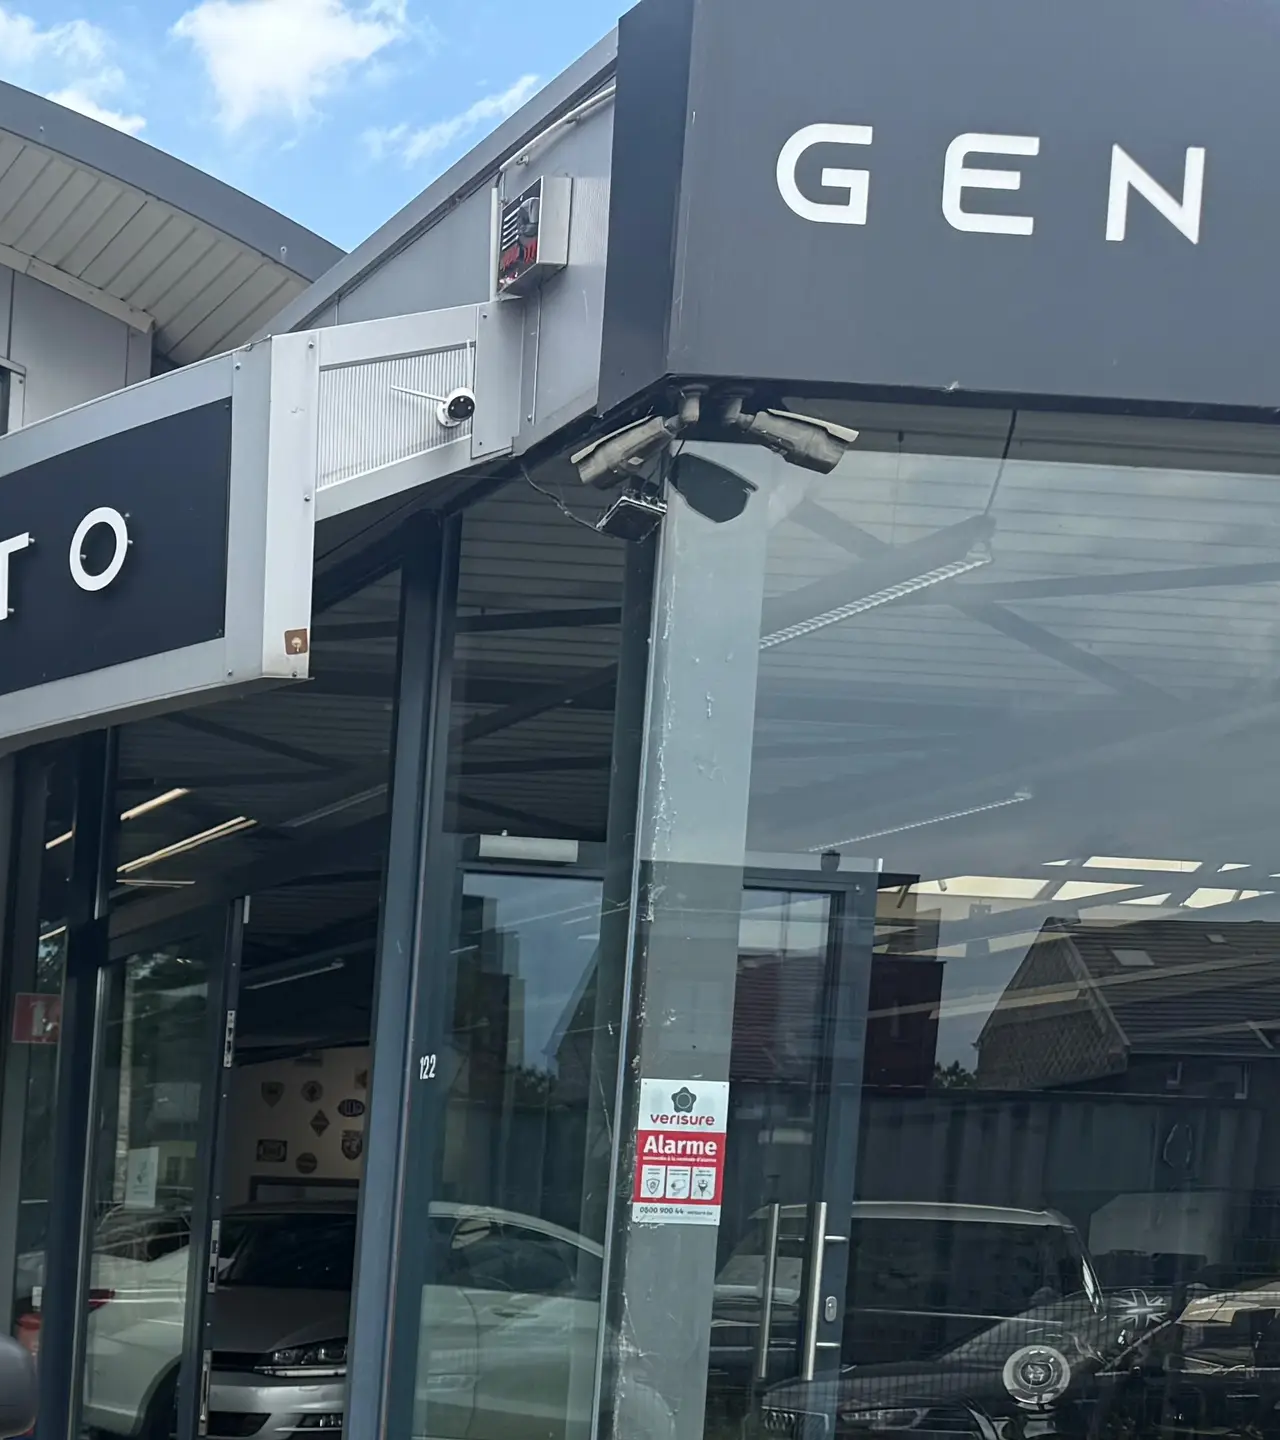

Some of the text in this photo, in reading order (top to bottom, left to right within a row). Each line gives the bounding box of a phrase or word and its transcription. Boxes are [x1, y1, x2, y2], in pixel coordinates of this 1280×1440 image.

[775, 122, 1206, 245] GEN
[419, 1054, 437, 1080] 122
[650, 1114, 715, 1126] verisure
[643, 1134, 717, 1155] Alarme
[659, 1207, 674, 1215] 900
